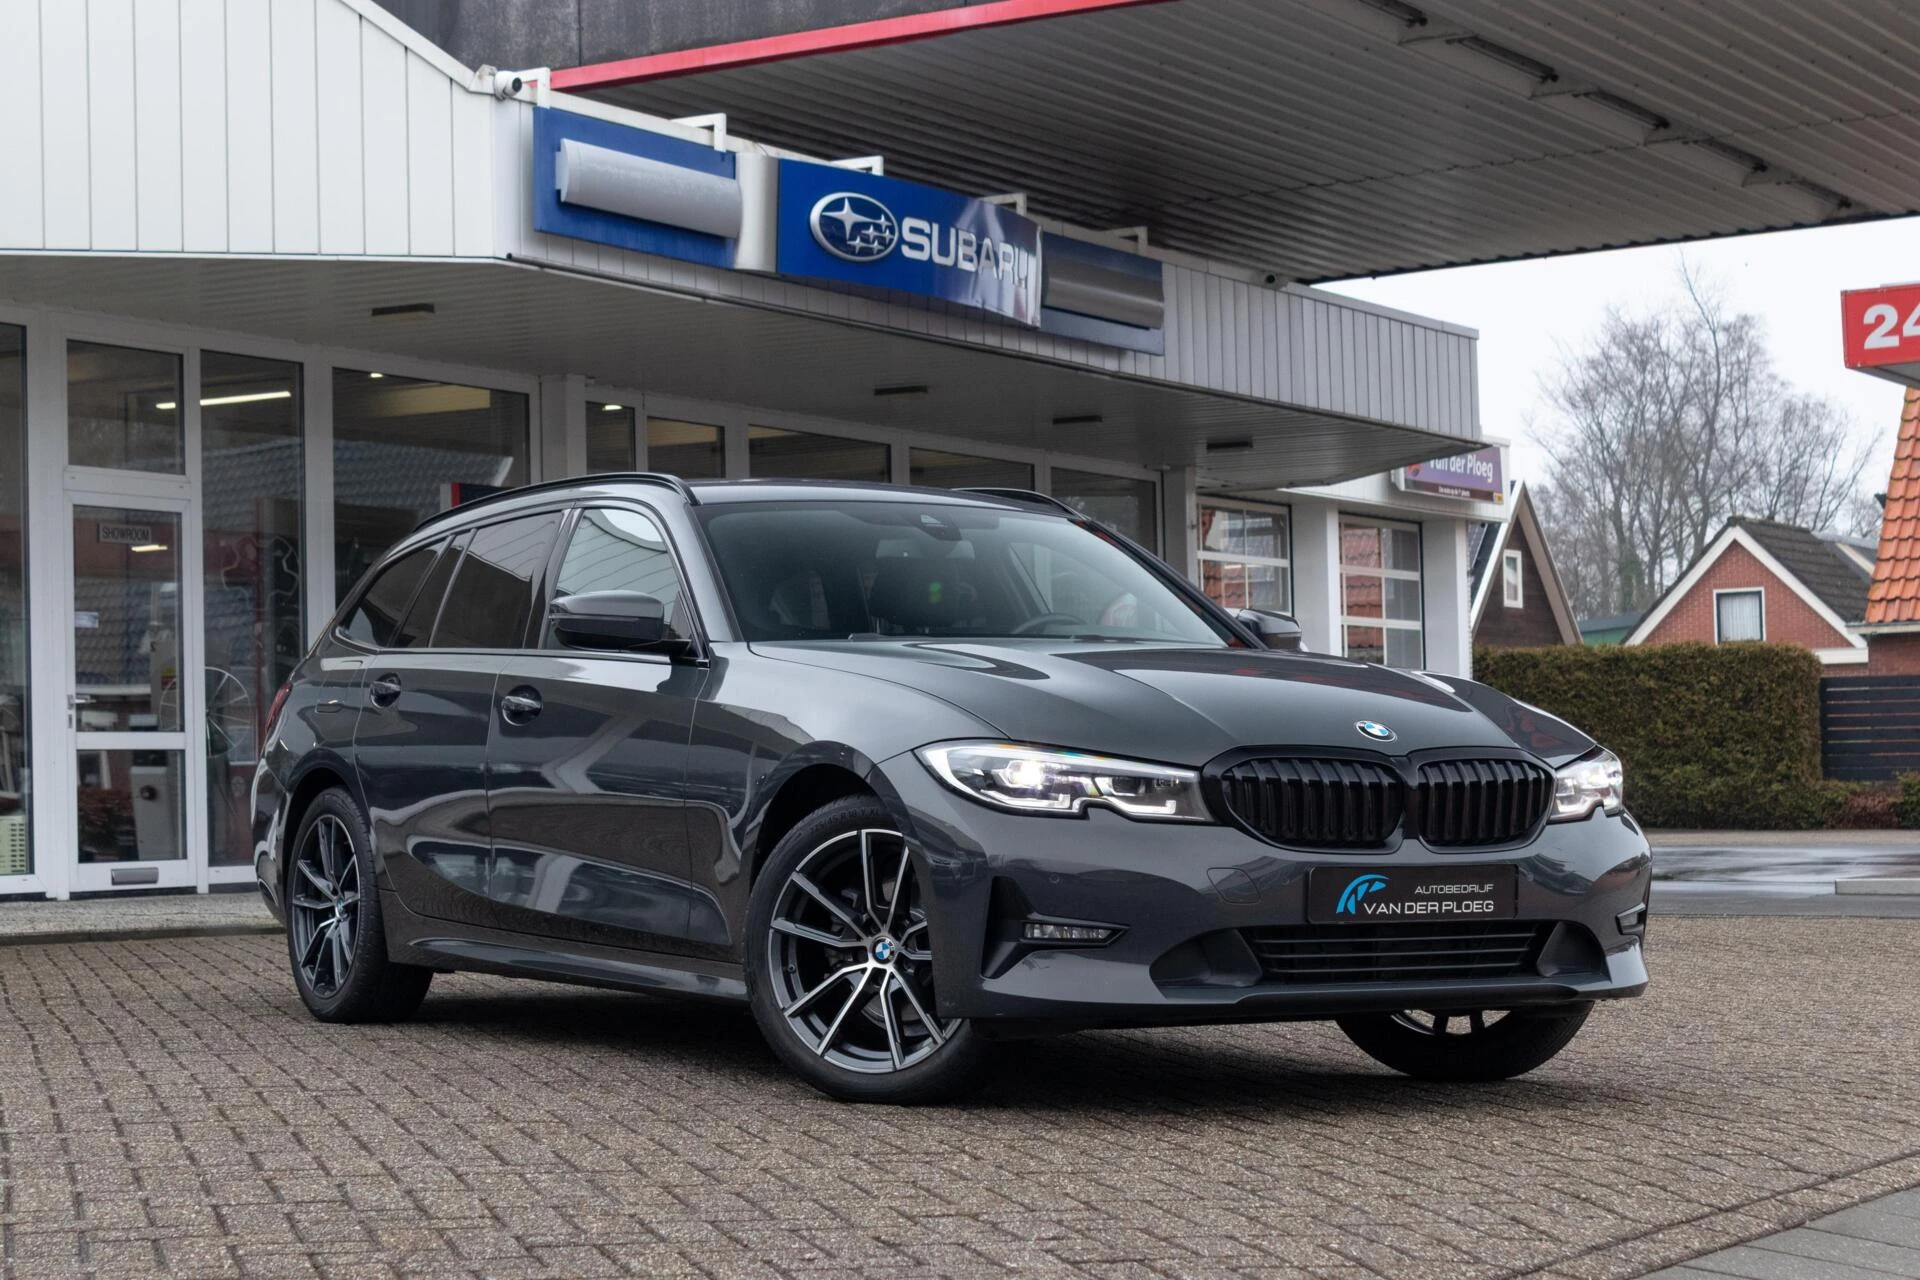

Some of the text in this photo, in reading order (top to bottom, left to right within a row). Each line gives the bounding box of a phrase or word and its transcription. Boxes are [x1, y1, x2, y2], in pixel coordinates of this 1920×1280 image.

[1449, 455, 1466, 473] der
[1467, 454, 1493, 483] Ploeg
[102, 526, 150, 542] SHOWROOM
[1414, 884, 1495, 895] AUTOBEDRIJF
[1363, 901, 1494, 915] VAN DER PLOEG
